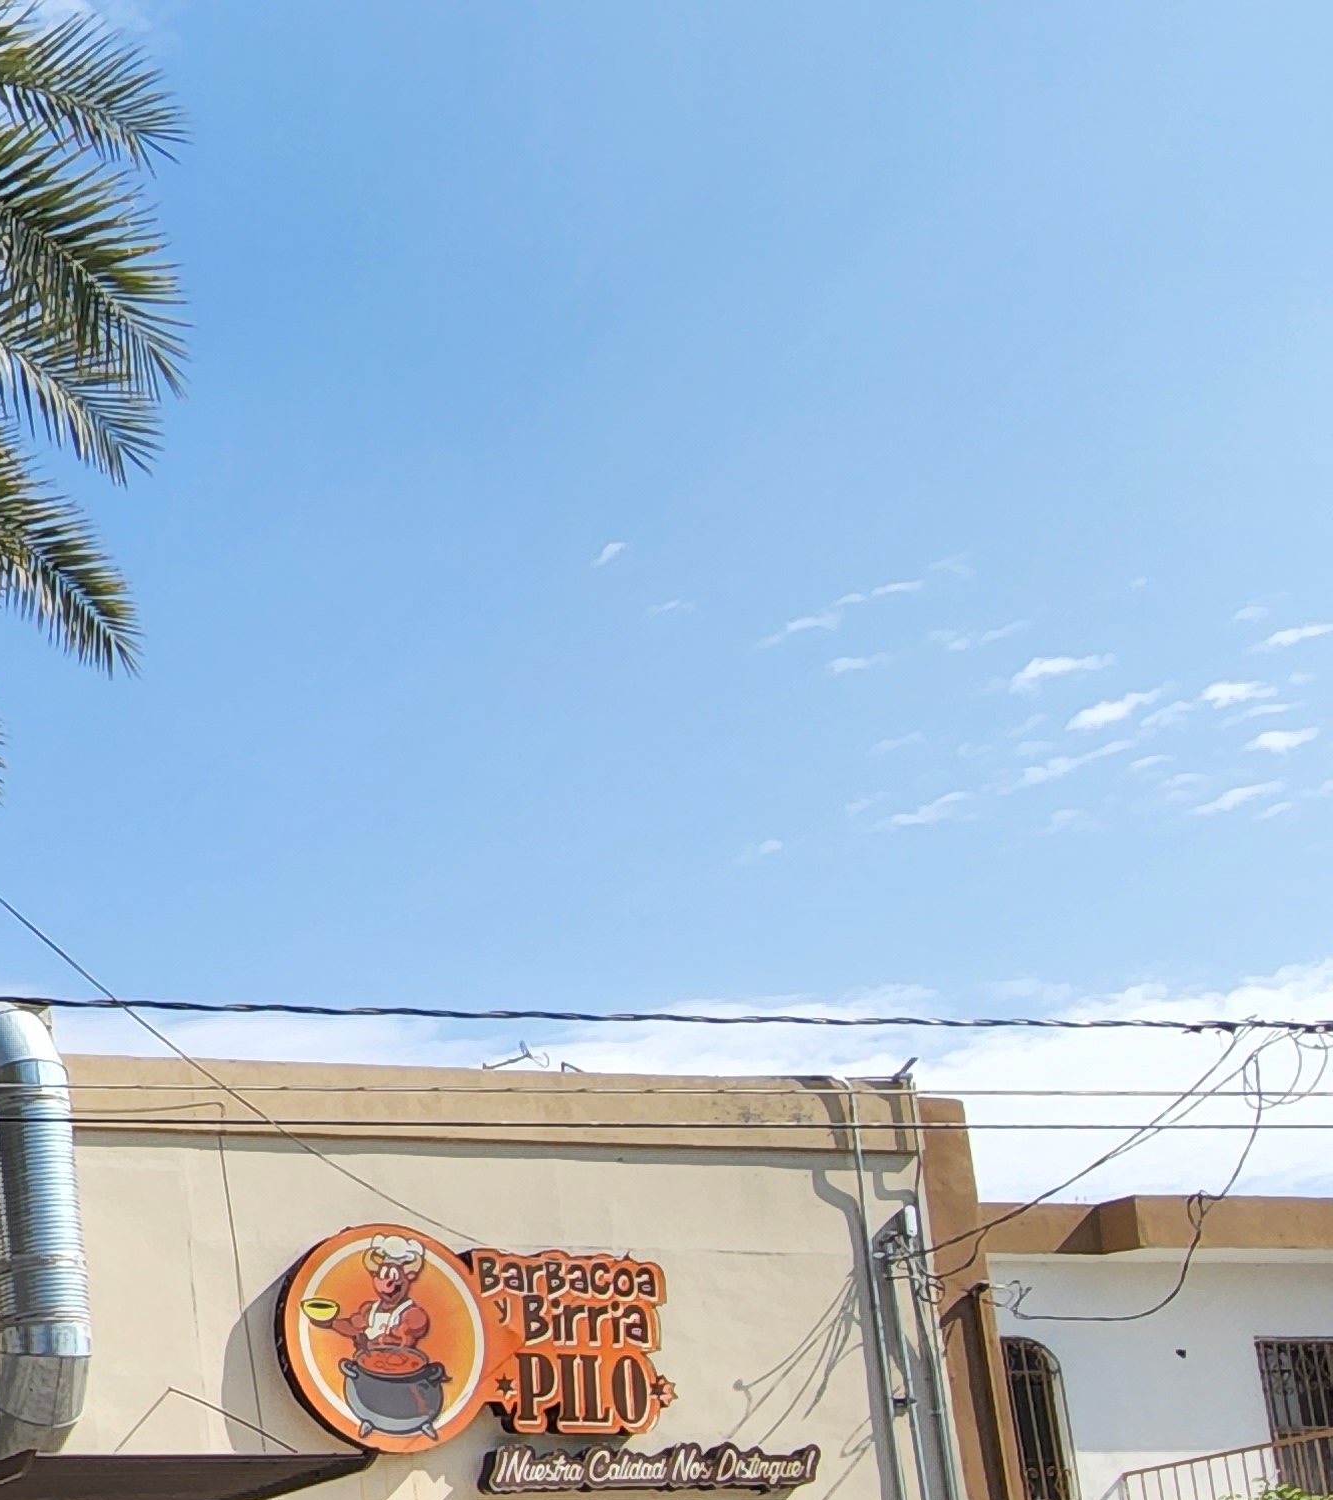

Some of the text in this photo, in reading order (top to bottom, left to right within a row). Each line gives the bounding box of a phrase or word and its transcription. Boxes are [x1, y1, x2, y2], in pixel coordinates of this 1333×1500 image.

[493, 1294, 650, 1345] y Birria
[515, 1352, 648, 1424] PILO
[589, 1450, 667, 1482] Calidad
[671, 1448, 713, 1482] Nos
[715, 1448, 816, 1485] Distingue!
